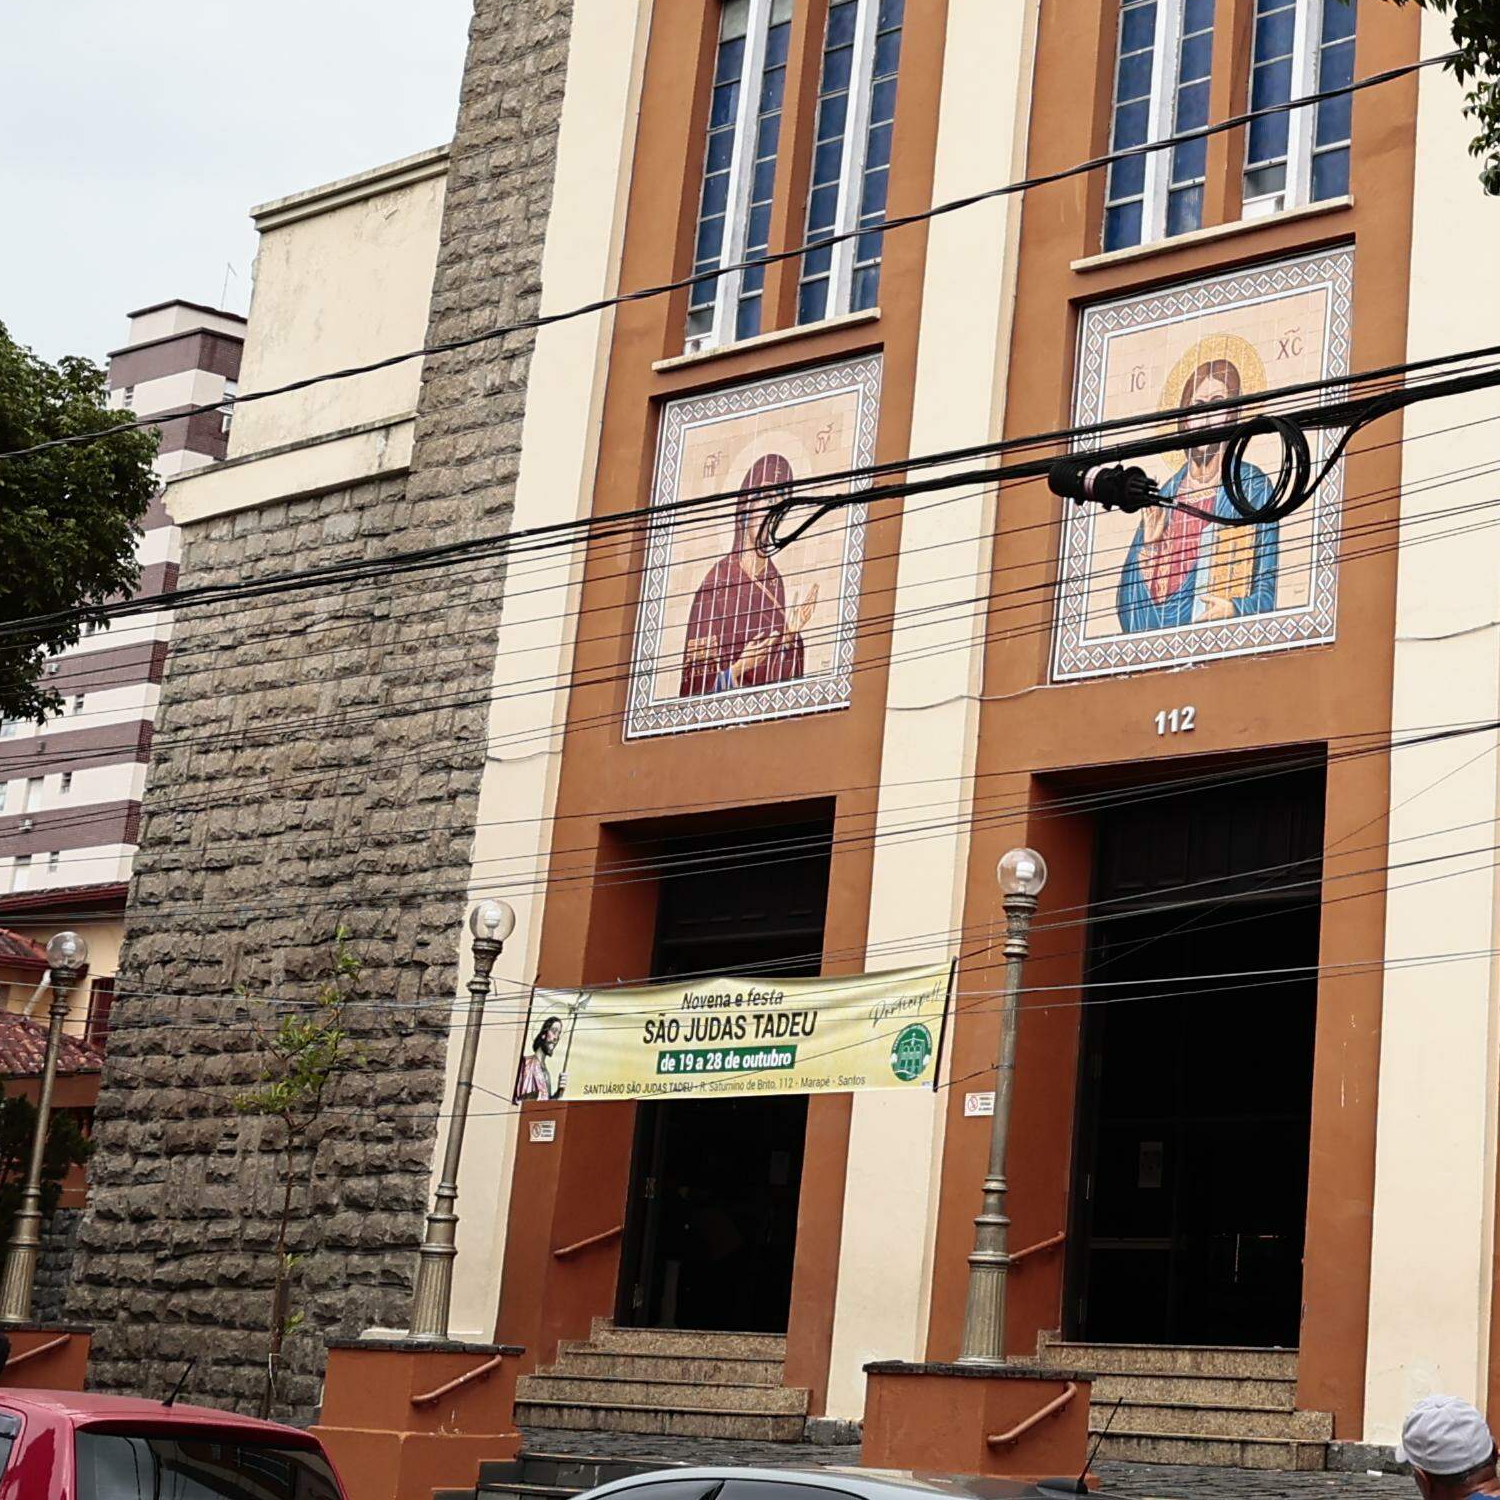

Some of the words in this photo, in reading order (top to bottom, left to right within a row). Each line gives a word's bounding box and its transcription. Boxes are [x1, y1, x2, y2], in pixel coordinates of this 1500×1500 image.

[1154, 706, 1196, 735] 112
[681, 993, 731, 1010] Novena
[735, 994, 743, 1006] e
[747, 988, 784, 1006] festa
[643, 1013, 680, 1044] SÃO
[684, 1015, 747, 1042] JUDAS
[752, 1011, 818, 1038] TADEU
[660, 1053, 675, 1072] de
[679, 1053, 694, 1071] 19
[695, 1057, 705, 1070] a
[706, 1052, 722, 1070] 28
[725, 1051, 740, 1069] de
[742, 1048, 792, 1068] outubro
[583, 1082, 624, 1094] SANTUÁRIO
[626, 1081, 641, 1093] SÃO
[642, 1082, 667, 1093] JUDAS
[669, 1082, 692, 1092] TADEU
[746, 1080, 755, 1090] de
[780, 1078, 793, 1089] 112
[800, 1077, 830, 1089] Marapé
[838, 1075, 866, 1086] Santos
